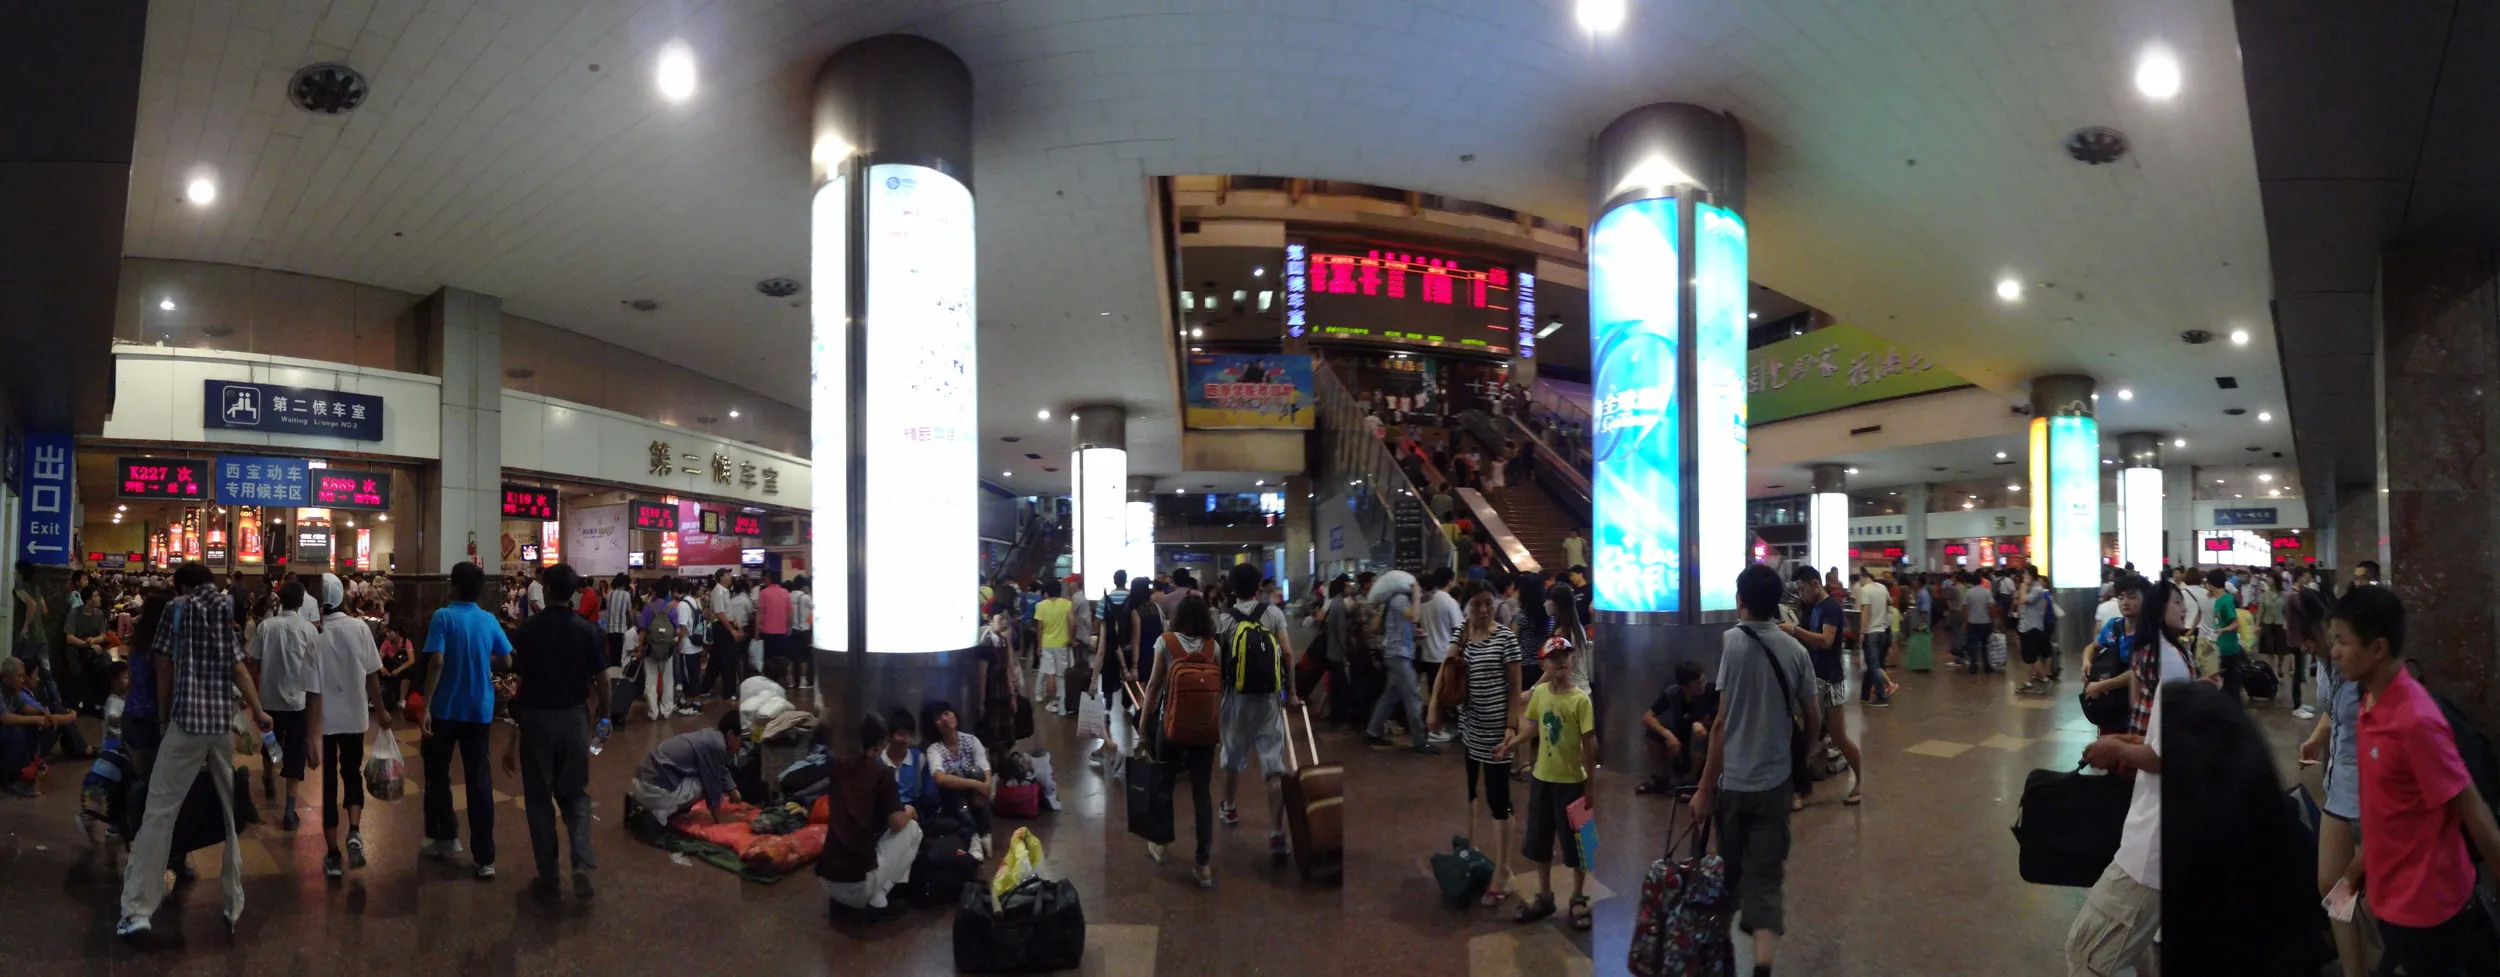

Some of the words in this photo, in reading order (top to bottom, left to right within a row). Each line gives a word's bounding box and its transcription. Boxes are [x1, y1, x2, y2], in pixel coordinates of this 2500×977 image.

[273, 396, 366, 420] 第二候车室
[281, 416, 308, 425] Waiting
[129, 466, 168, 481] K227
[225, 462, 303, 482] 西宝动车
[648, 440, 779, 495] 第二候车室
[32, 445, 65, 513] 出口
[225, 481, 303, 500] 专用候车区
[30, 521, 60, 535] Exit
